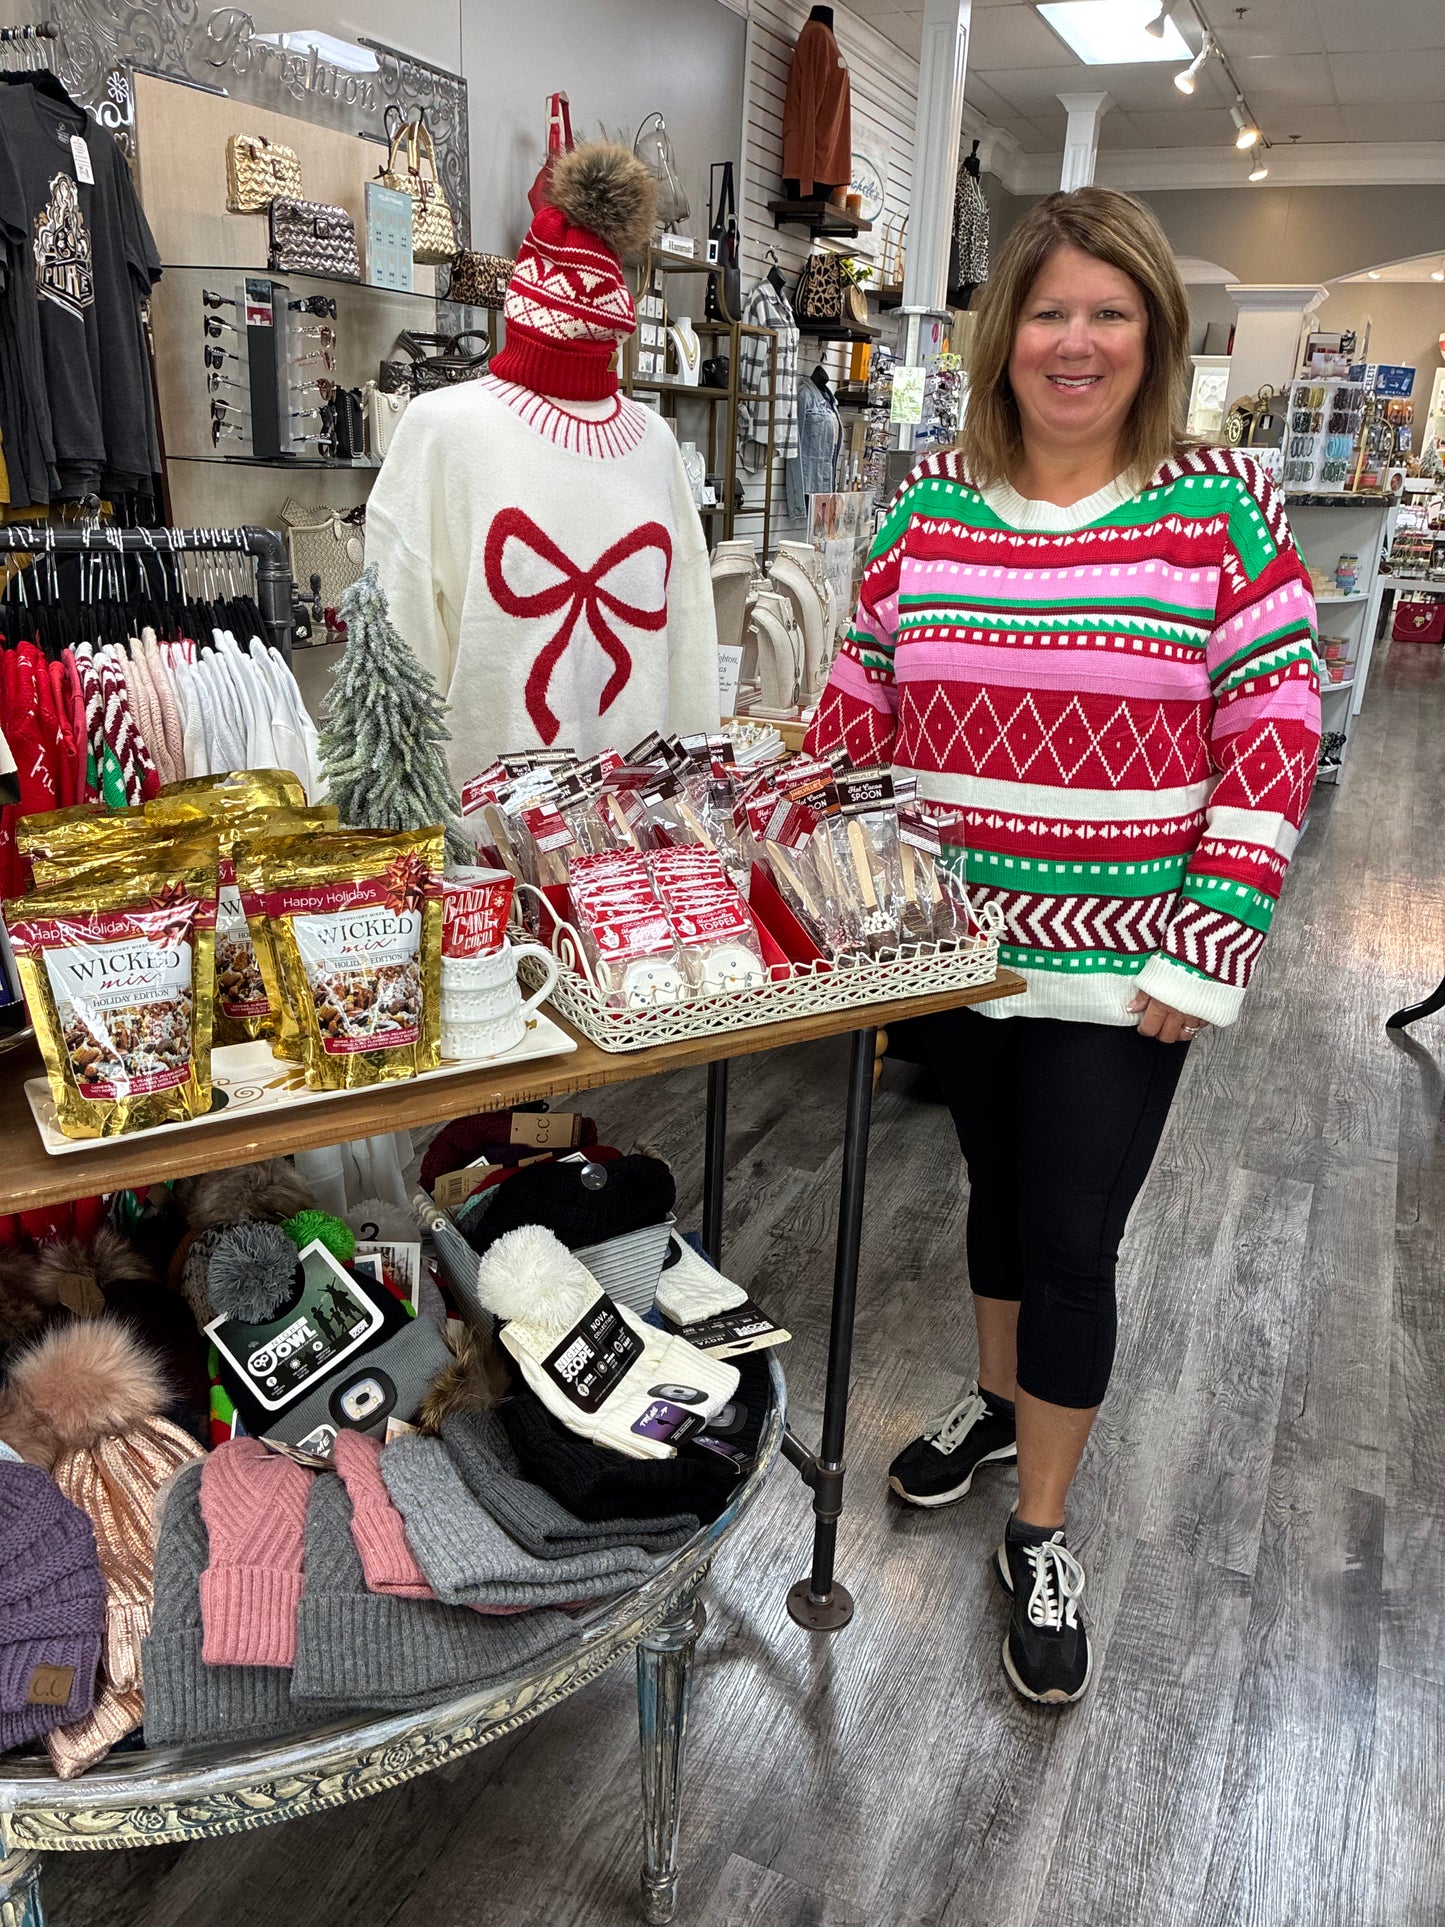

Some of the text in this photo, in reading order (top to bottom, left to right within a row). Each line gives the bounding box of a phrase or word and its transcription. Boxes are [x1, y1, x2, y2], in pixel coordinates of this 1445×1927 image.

[44, 264, 90, 300] PURE
[847, 783, 883, 794] Hot Cocoa
[850, 789, 882, 802] SPOON
[283, 887, 377, 909] Happy Holidays
[443, 886, 496, 925] CANDY
[31, 919, 138, 941] Happy Holidays
[317, 917, 414, 946] WICKED
[452, 908, 499, 946] CANE
[699, 916, 738, 931] TOPPER
[340, 937, 393, 955] mix
[464, 929, 493, 951] COCOA
[68, 950, 181, 982] WICKED
[370, 952, 403, 964] EDITION
[99, 972, 159, 990] mix
[92, 988, 169, 1008] HOLIDAY EDITION
[590, 1310, 609, 1331] NOVA
[593, 1313, 615, 1339] COLLECTION
[271, 1321, 304, 1347] NIGHT
[275, 1324, 317, 1358] OWL
[697, 1336, 725, 1346] NOVA
[557, 1340, 584, 1370] NIGHT
[561, 1344, 596, 1383] SCOPE
[33, 1677, 65, 1698] C.C
